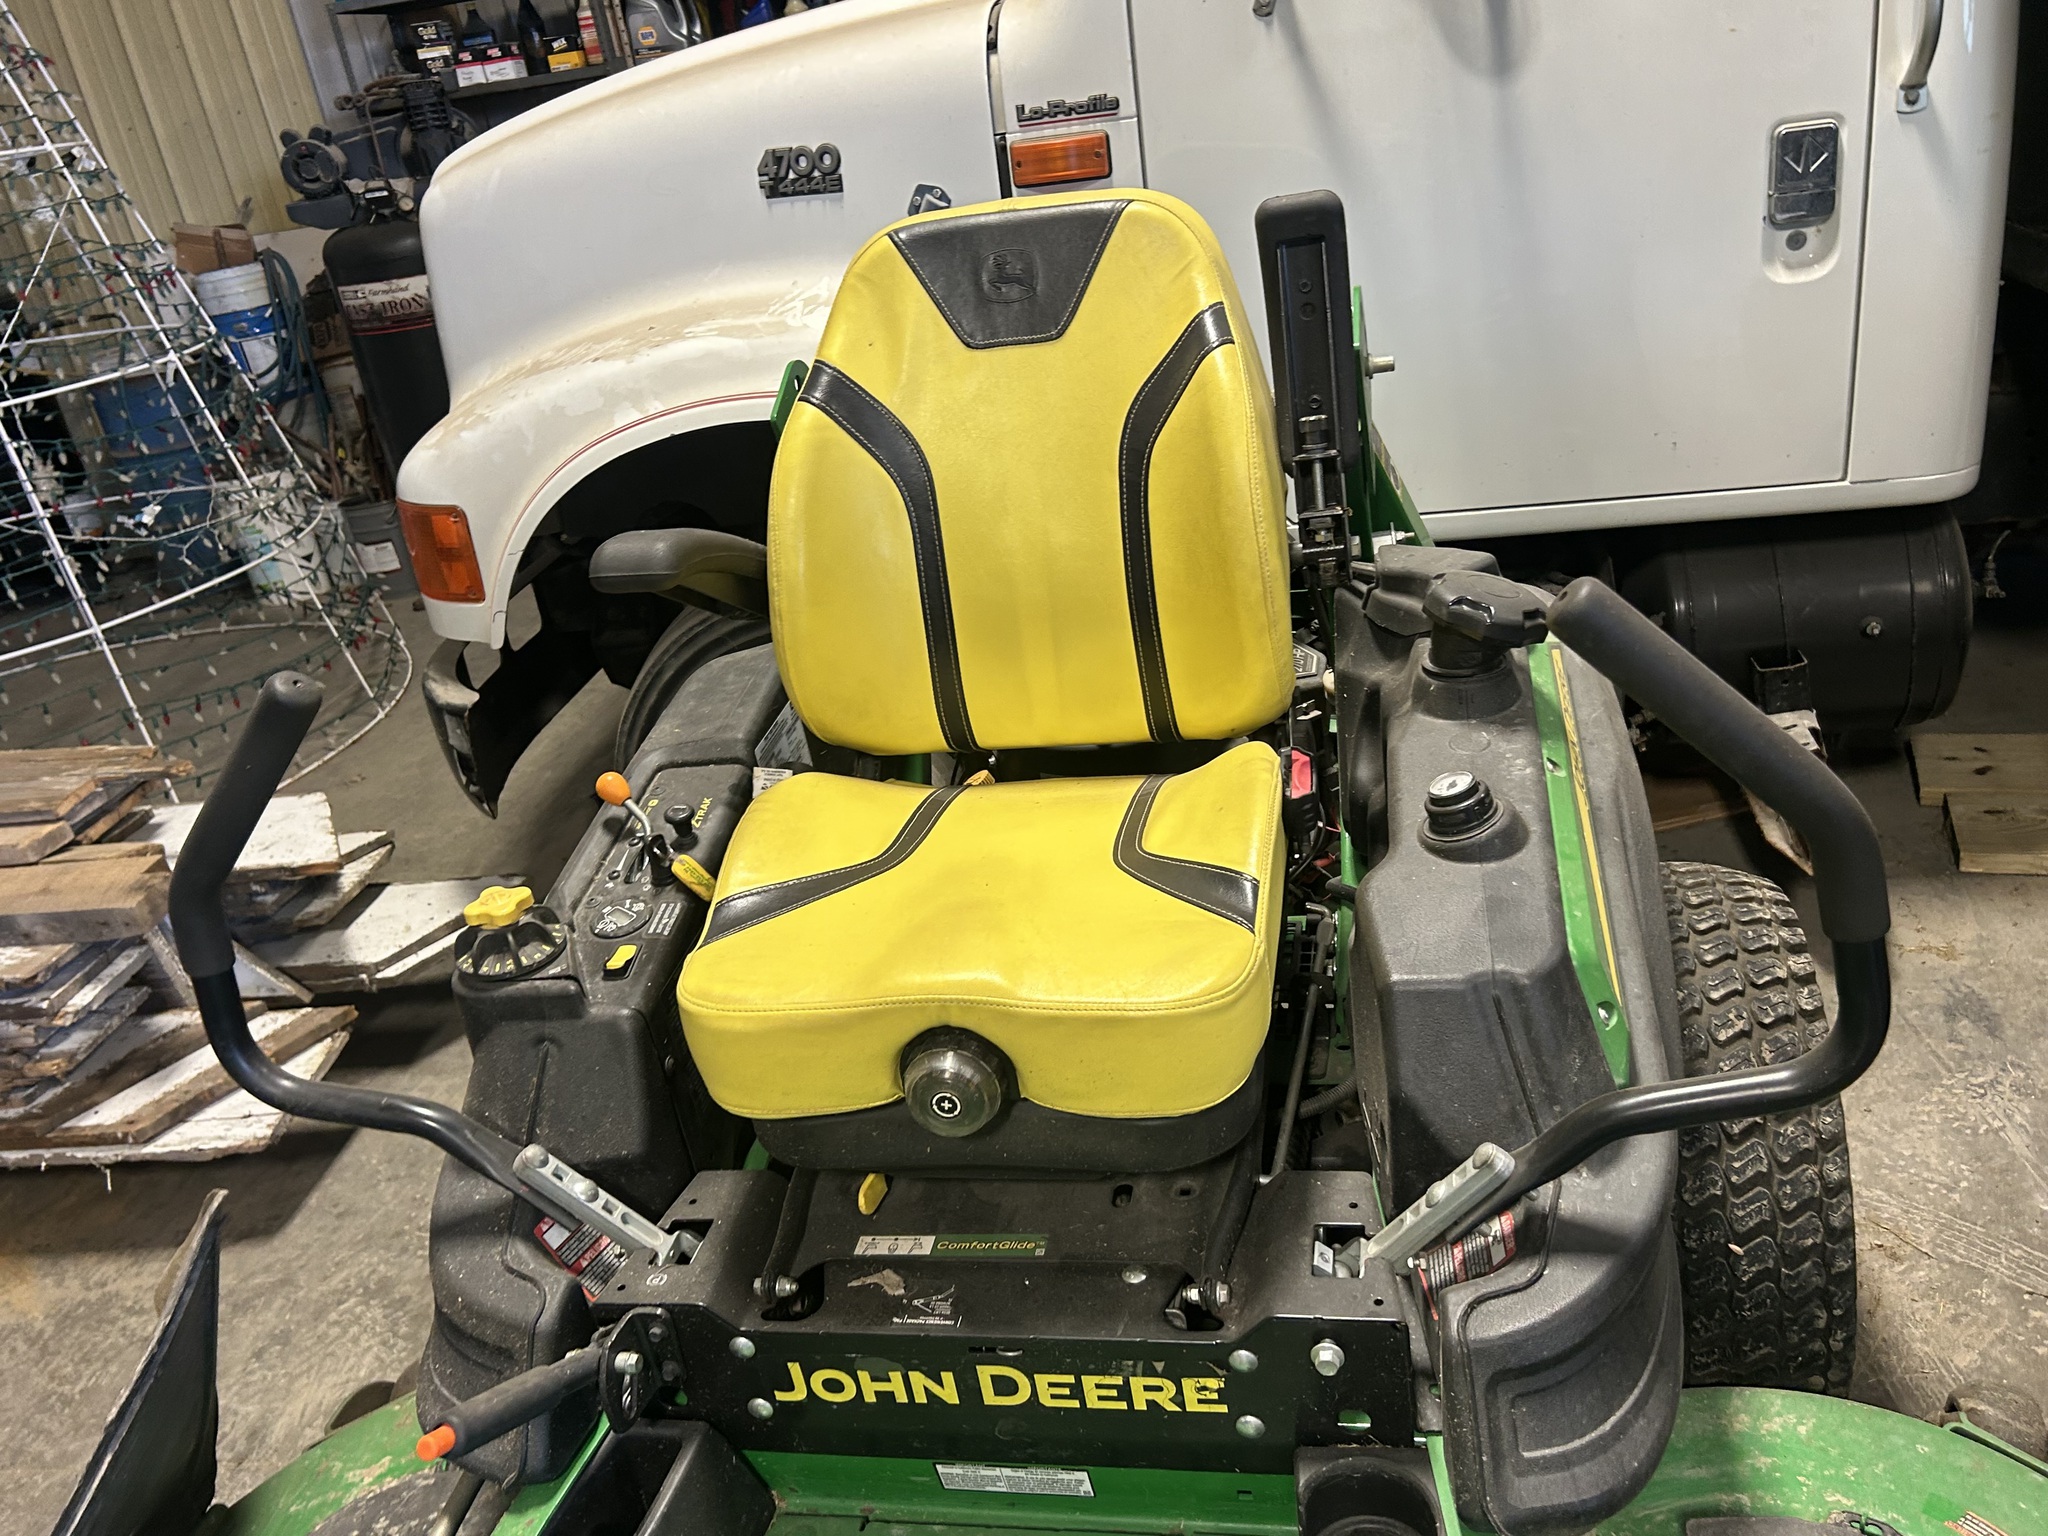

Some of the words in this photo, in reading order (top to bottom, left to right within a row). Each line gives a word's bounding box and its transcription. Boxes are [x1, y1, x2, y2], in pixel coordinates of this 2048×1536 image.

[1015, 93, 1120, 123] Lo-Profile
[757, 143, 842, 179] 4700
[759, 180, 775, 199] T
[778, 174, 843, 194] 444E
[380, 292, 429, 316] IRON
[937, 1240, 1036, 1250] ComfortGlide
[774, 1361, 960, 1405] JOHN
[975, 1364, 1230, 1413] DEERE
